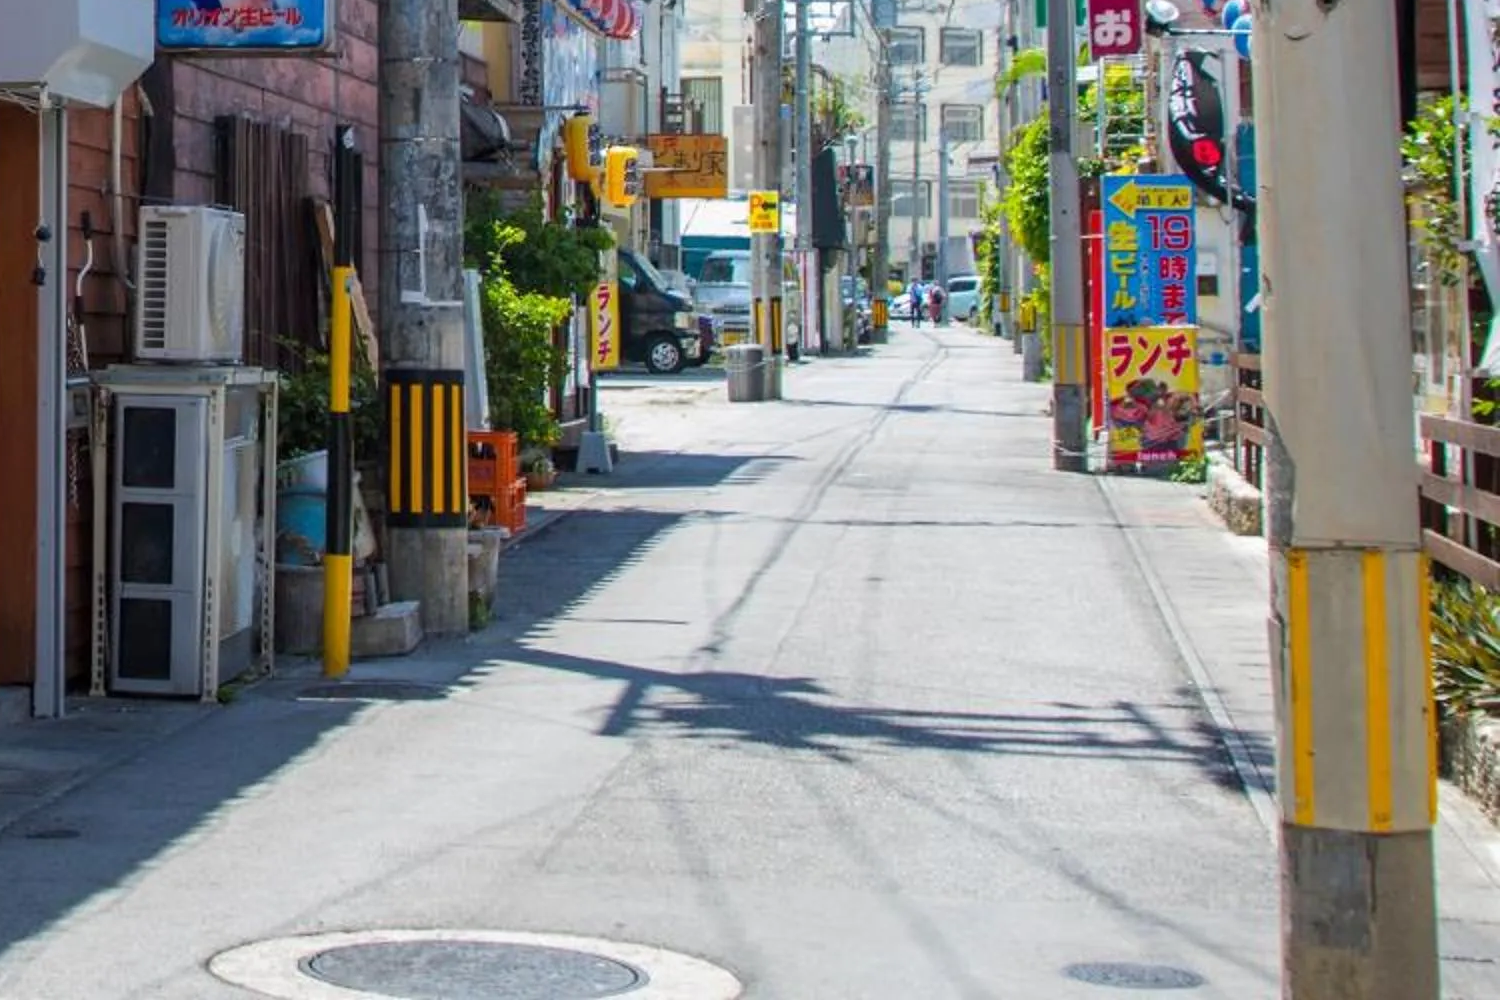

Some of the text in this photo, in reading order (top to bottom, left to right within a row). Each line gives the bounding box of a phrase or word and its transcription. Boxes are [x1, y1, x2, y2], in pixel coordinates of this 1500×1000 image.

[173, 7, 302, 27] オリオン生ビール
[1107, 220, 1139, 311] 生ビール
[597, 283, 612, 364] ランチ
[1110, 331, 1192, 377] ランチ
